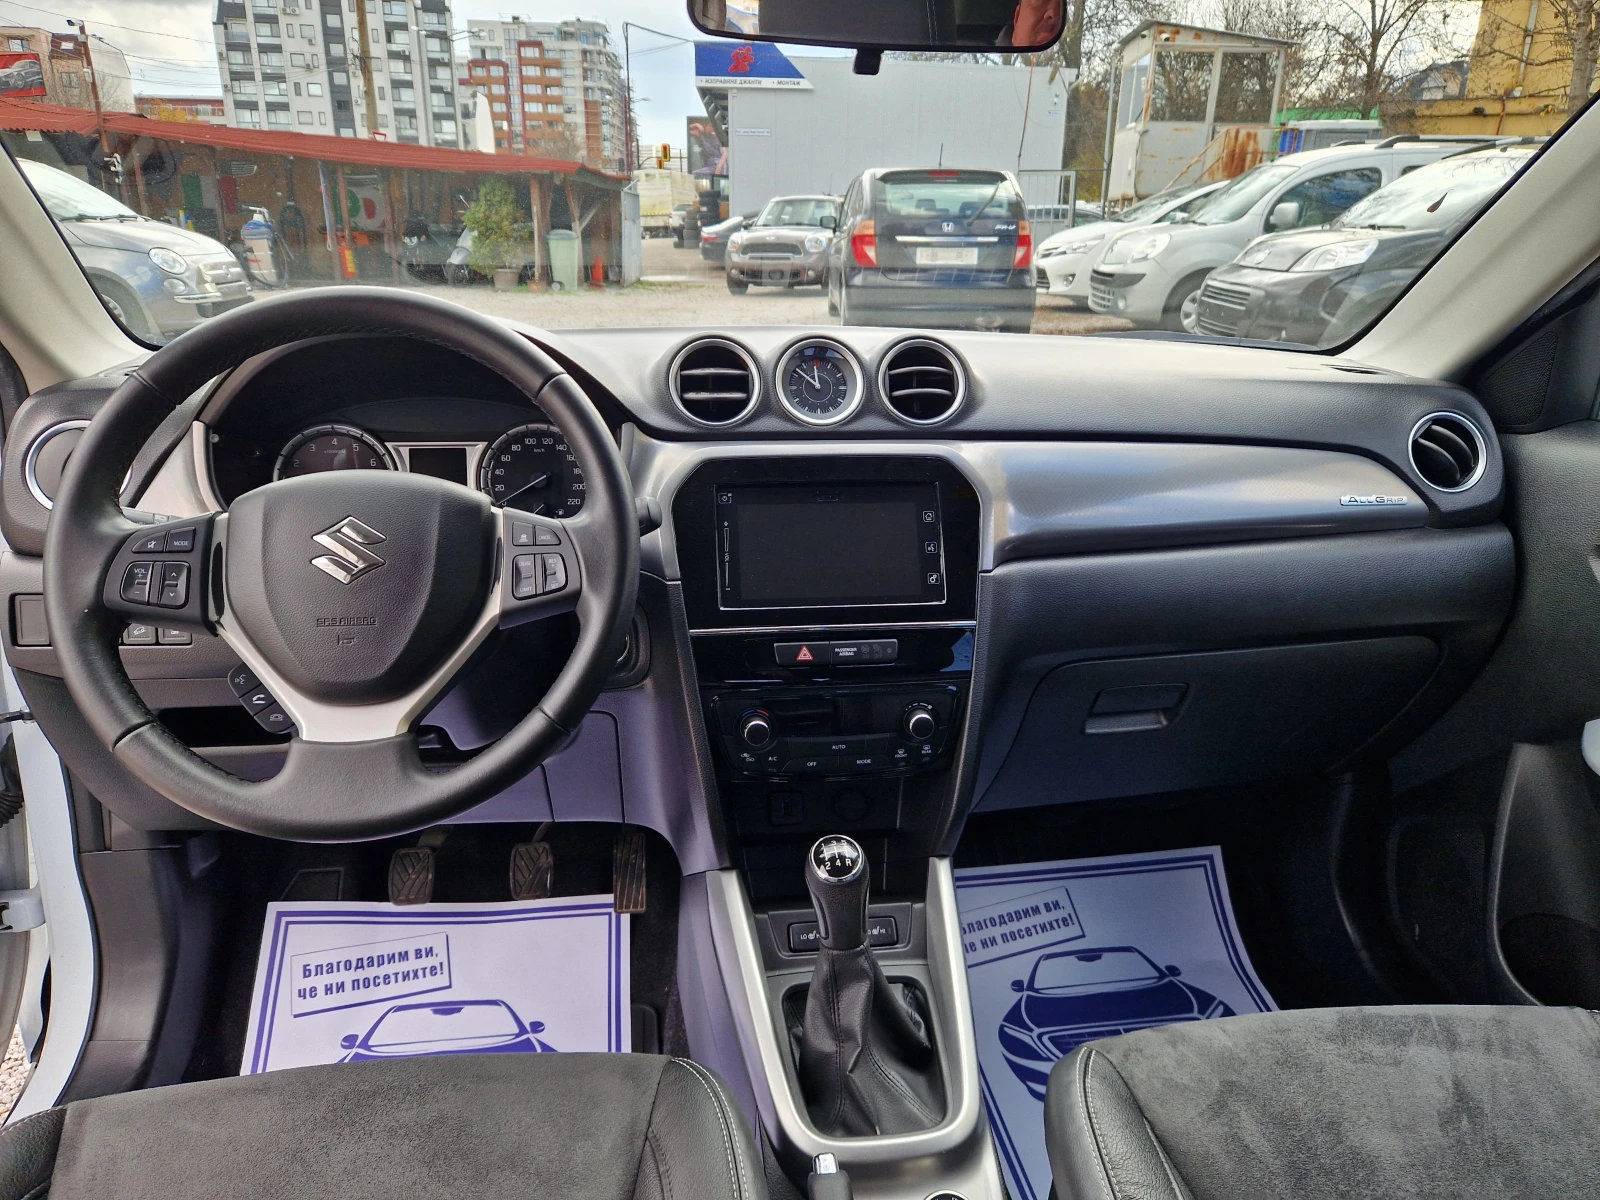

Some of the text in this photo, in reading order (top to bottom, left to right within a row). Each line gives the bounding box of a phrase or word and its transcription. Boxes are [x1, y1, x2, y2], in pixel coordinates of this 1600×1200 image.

[331, 437, 338, 446] 4
[524, 437, 537, 446] 100
[541, 437, 554, 446] 120
[309, 443, 316, 452] 3
[353, 443, 360, 452] 5
[511, 444, 521, 452] 80
[555, 444, 568, 452] 140
[370, 458, 377, 467] 6
[500, 454, 511, 462] 60
[293, 459, 300, 468] 2
[494, 468, 505, 476] 40
[494, 484, 505, 492] 20
[567, 498, 581, 506] 220
[339, 616, 378, 626] AIRBAG
[825, 858, 852, 871] 2 4 R
[1043, 899, 1066, 914] ви,
[980, 934, 999, 950] ни
[999, 912, 1075, 944] посетихте!
[302, 945, 439, 979] Благодарим ви,
[297, 961, 445, 1000] че ни посетихте!
